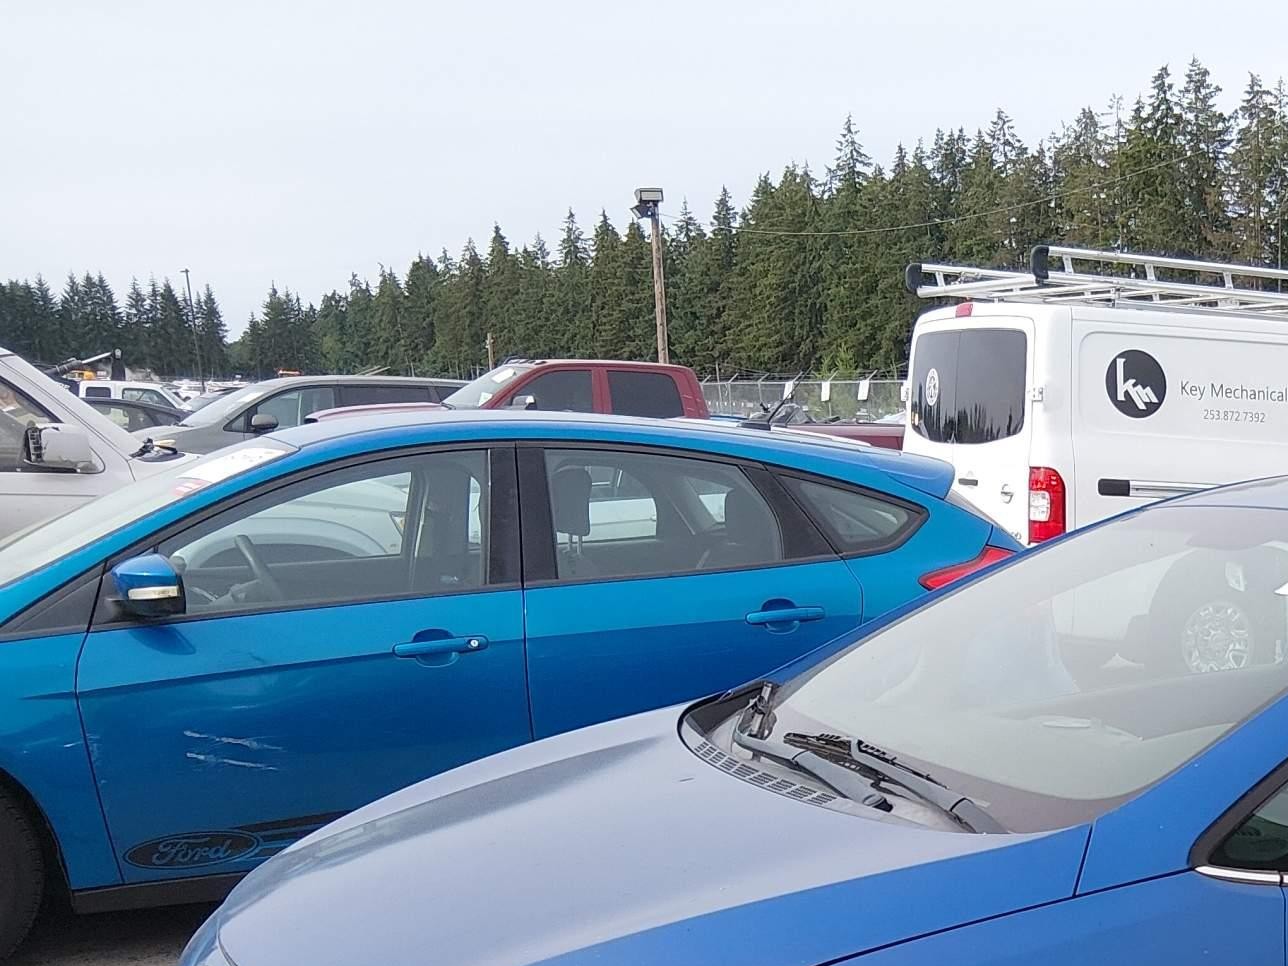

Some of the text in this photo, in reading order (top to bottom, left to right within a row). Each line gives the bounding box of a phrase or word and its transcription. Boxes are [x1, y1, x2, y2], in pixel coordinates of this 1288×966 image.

[1180, 380, 1288, 402] Key Mechanical
[1203, 409, 1266, 423] 253.872.7392
[152, 838, 232, 866] Ford
